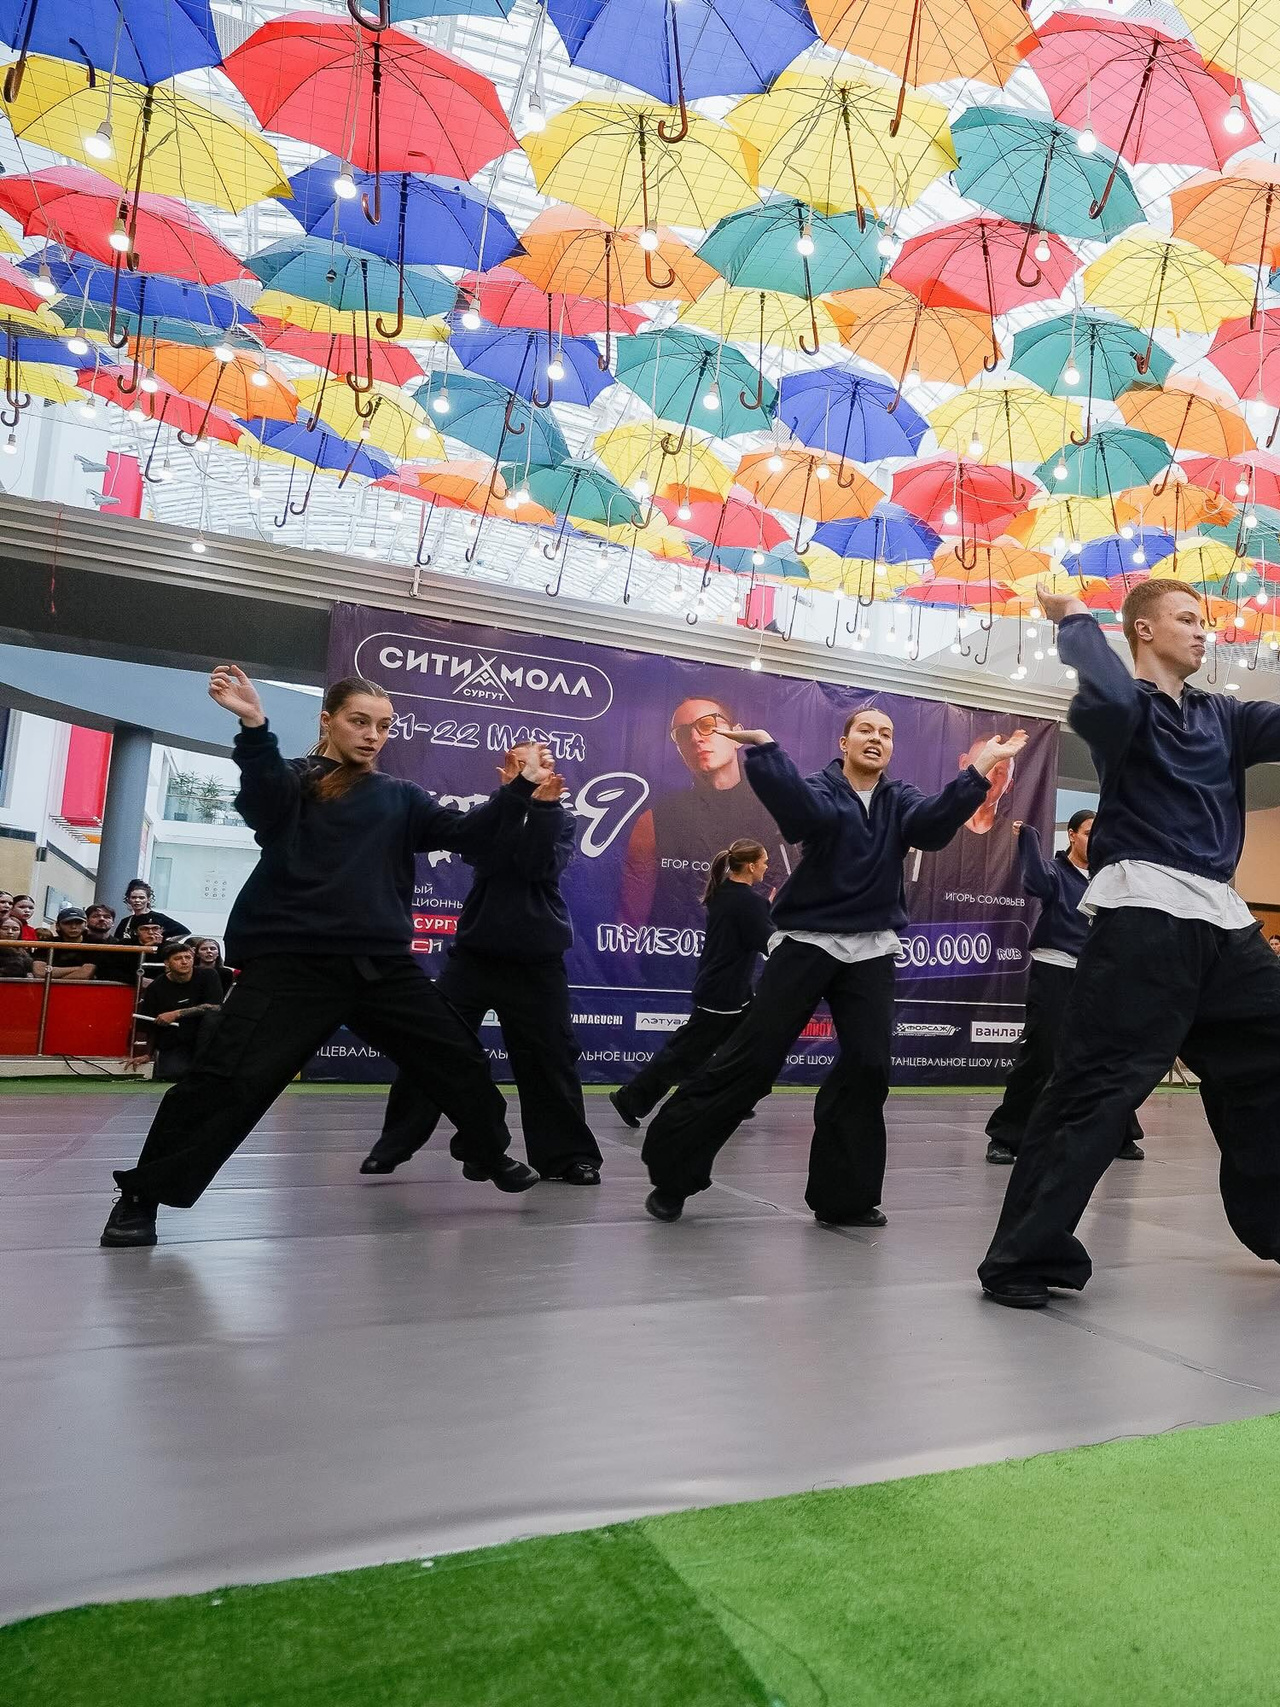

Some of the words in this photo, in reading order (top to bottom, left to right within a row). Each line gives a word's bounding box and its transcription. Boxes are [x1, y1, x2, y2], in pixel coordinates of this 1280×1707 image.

[463, 688, 504, 701] СУРГУТ
[661, 858, 689, 869] ЕГОР
[692, 861, 711, 872] СО
[945, 892, 976, 904] ИГОРЬ
[977, 894, 1026, 907] СОЛОВЬЕВ
[623, 1052, 655, 1063] ШОУ
[807, 1055, 835, 1066] ШОУ
[890, 1056, 967, 1068] ТАНЦЕВАЛЬНОЕ
[968, 1058, 993, 1068] ШОУ
